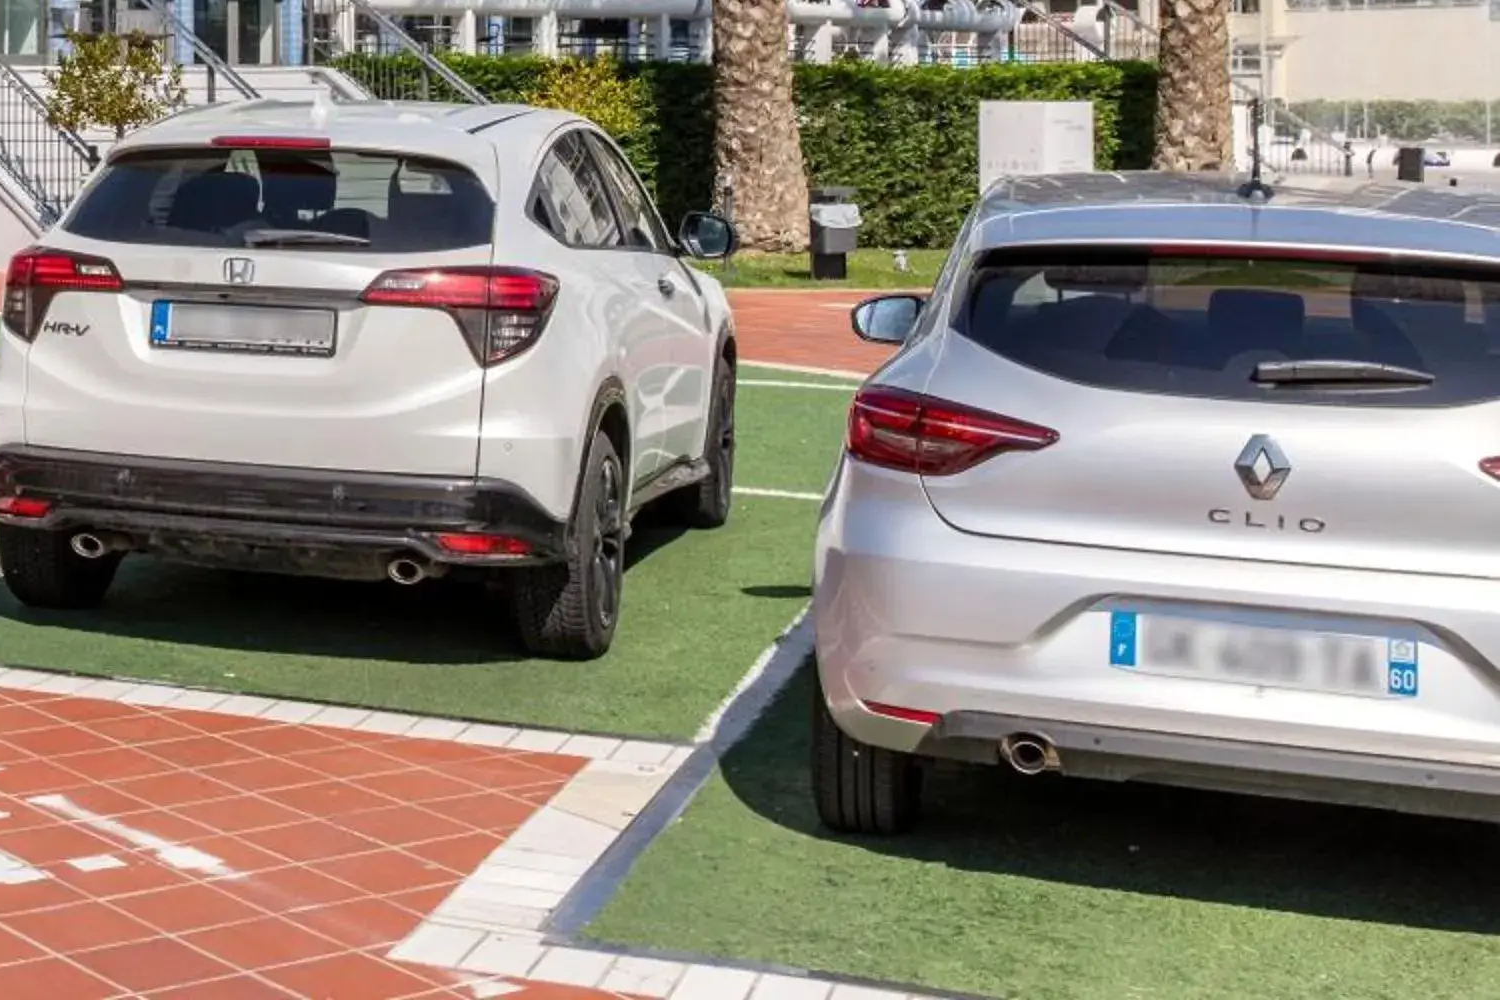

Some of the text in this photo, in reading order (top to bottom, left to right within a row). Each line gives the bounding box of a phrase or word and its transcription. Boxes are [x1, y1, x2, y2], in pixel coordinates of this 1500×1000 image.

[43, 320, 90, 337] HR-V
[1208, 508, 1326, 534] CLIO
[1389, 667, 1416, 691] 60
